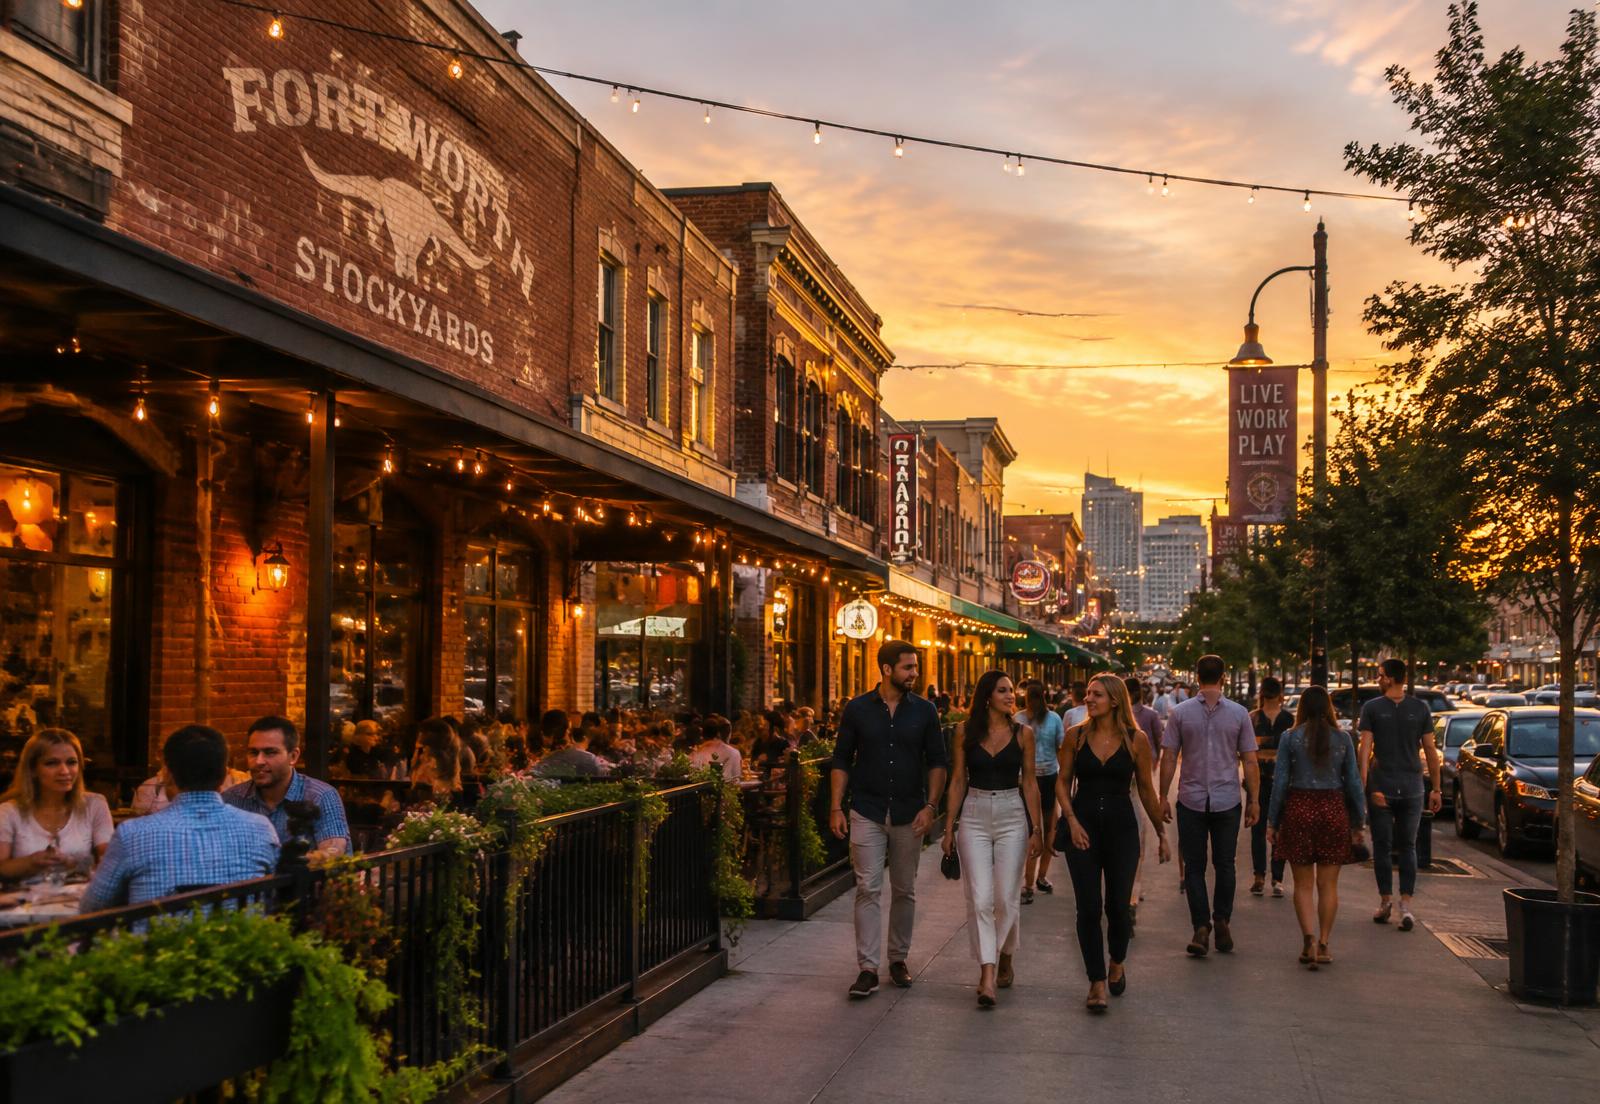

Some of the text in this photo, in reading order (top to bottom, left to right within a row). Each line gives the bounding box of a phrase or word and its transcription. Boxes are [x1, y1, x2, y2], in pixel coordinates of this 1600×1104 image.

[222, 67, 385, 142] FORT
[296, 236, 494, 365] STOCKYARDS
[1240, 384, 1284, 404] LIVE
[1236, 409, 1289, 429] WORK
[1239, 435, 1286, 455] PLAY
